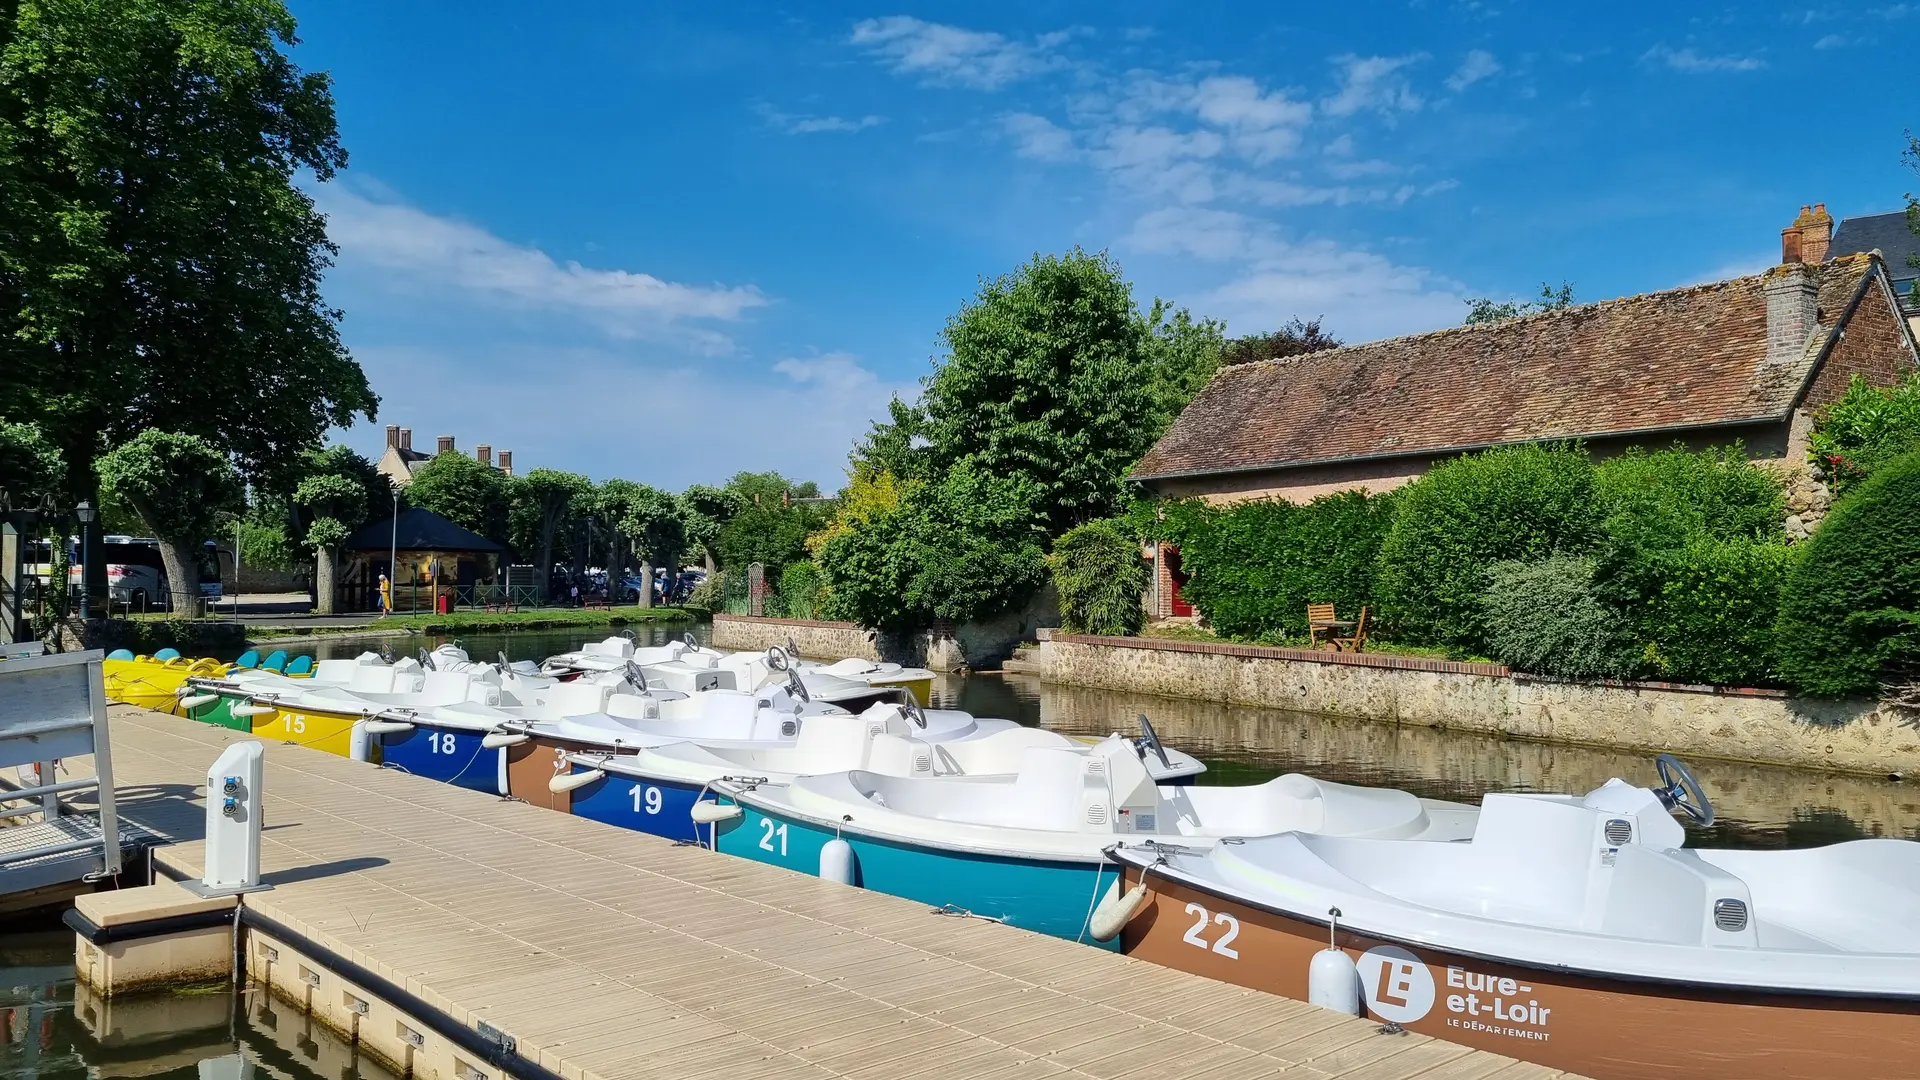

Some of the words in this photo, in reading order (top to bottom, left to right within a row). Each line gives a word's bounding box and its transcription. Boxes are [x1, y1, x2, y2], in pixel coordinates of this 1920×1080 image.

[282, 713, 306, 734] 15
[428, 732, 456, 755] 18
[628, 784, 662, 815] 19
[759, 817, 788, 857] 21
[1182, 902, 1241, 961] 22
[1446, 965, 1532, 997] Eure-
[1446, 993, 1551, 1026] et-Loir
[1446, 1017, 1460, 1028] LE
[1463, 1020, 1550, 1042] DÉPARTEMENT
